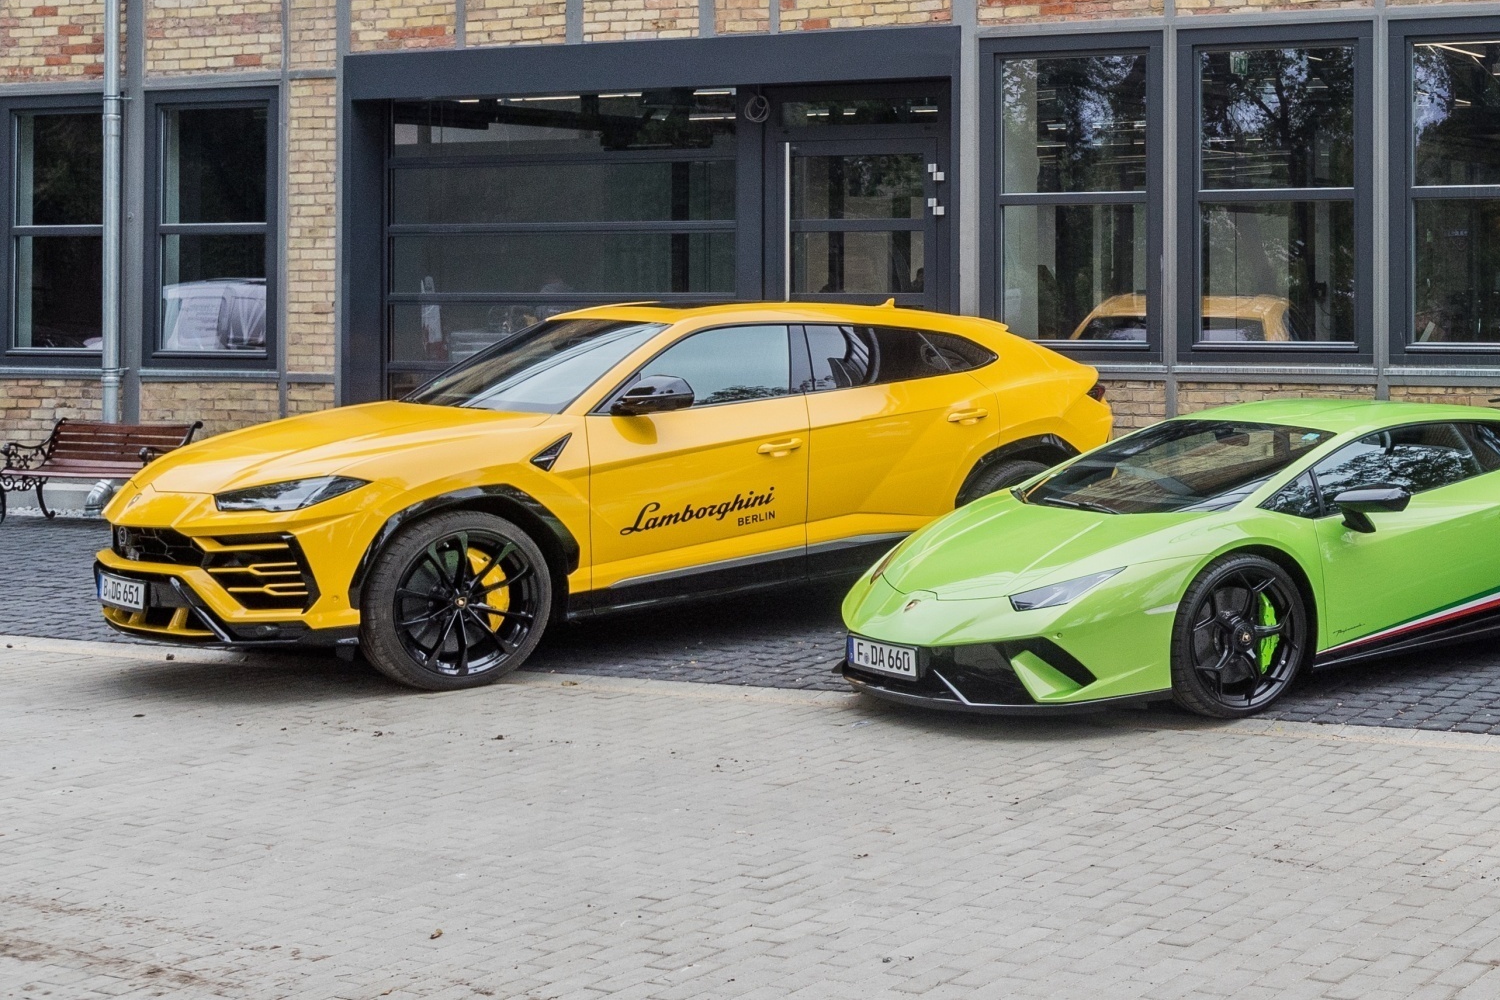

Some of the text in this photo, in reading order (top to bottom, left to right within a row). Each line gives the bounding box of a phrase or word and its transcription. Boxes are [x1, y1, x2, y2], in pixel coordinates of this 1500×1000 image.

[620, 486, 775, 536] Lamborghini
[737, 510, 776, 527] BERLIN
[123, 584, 140, 606] 651
[857, 642, 911, 672] F DA 660
